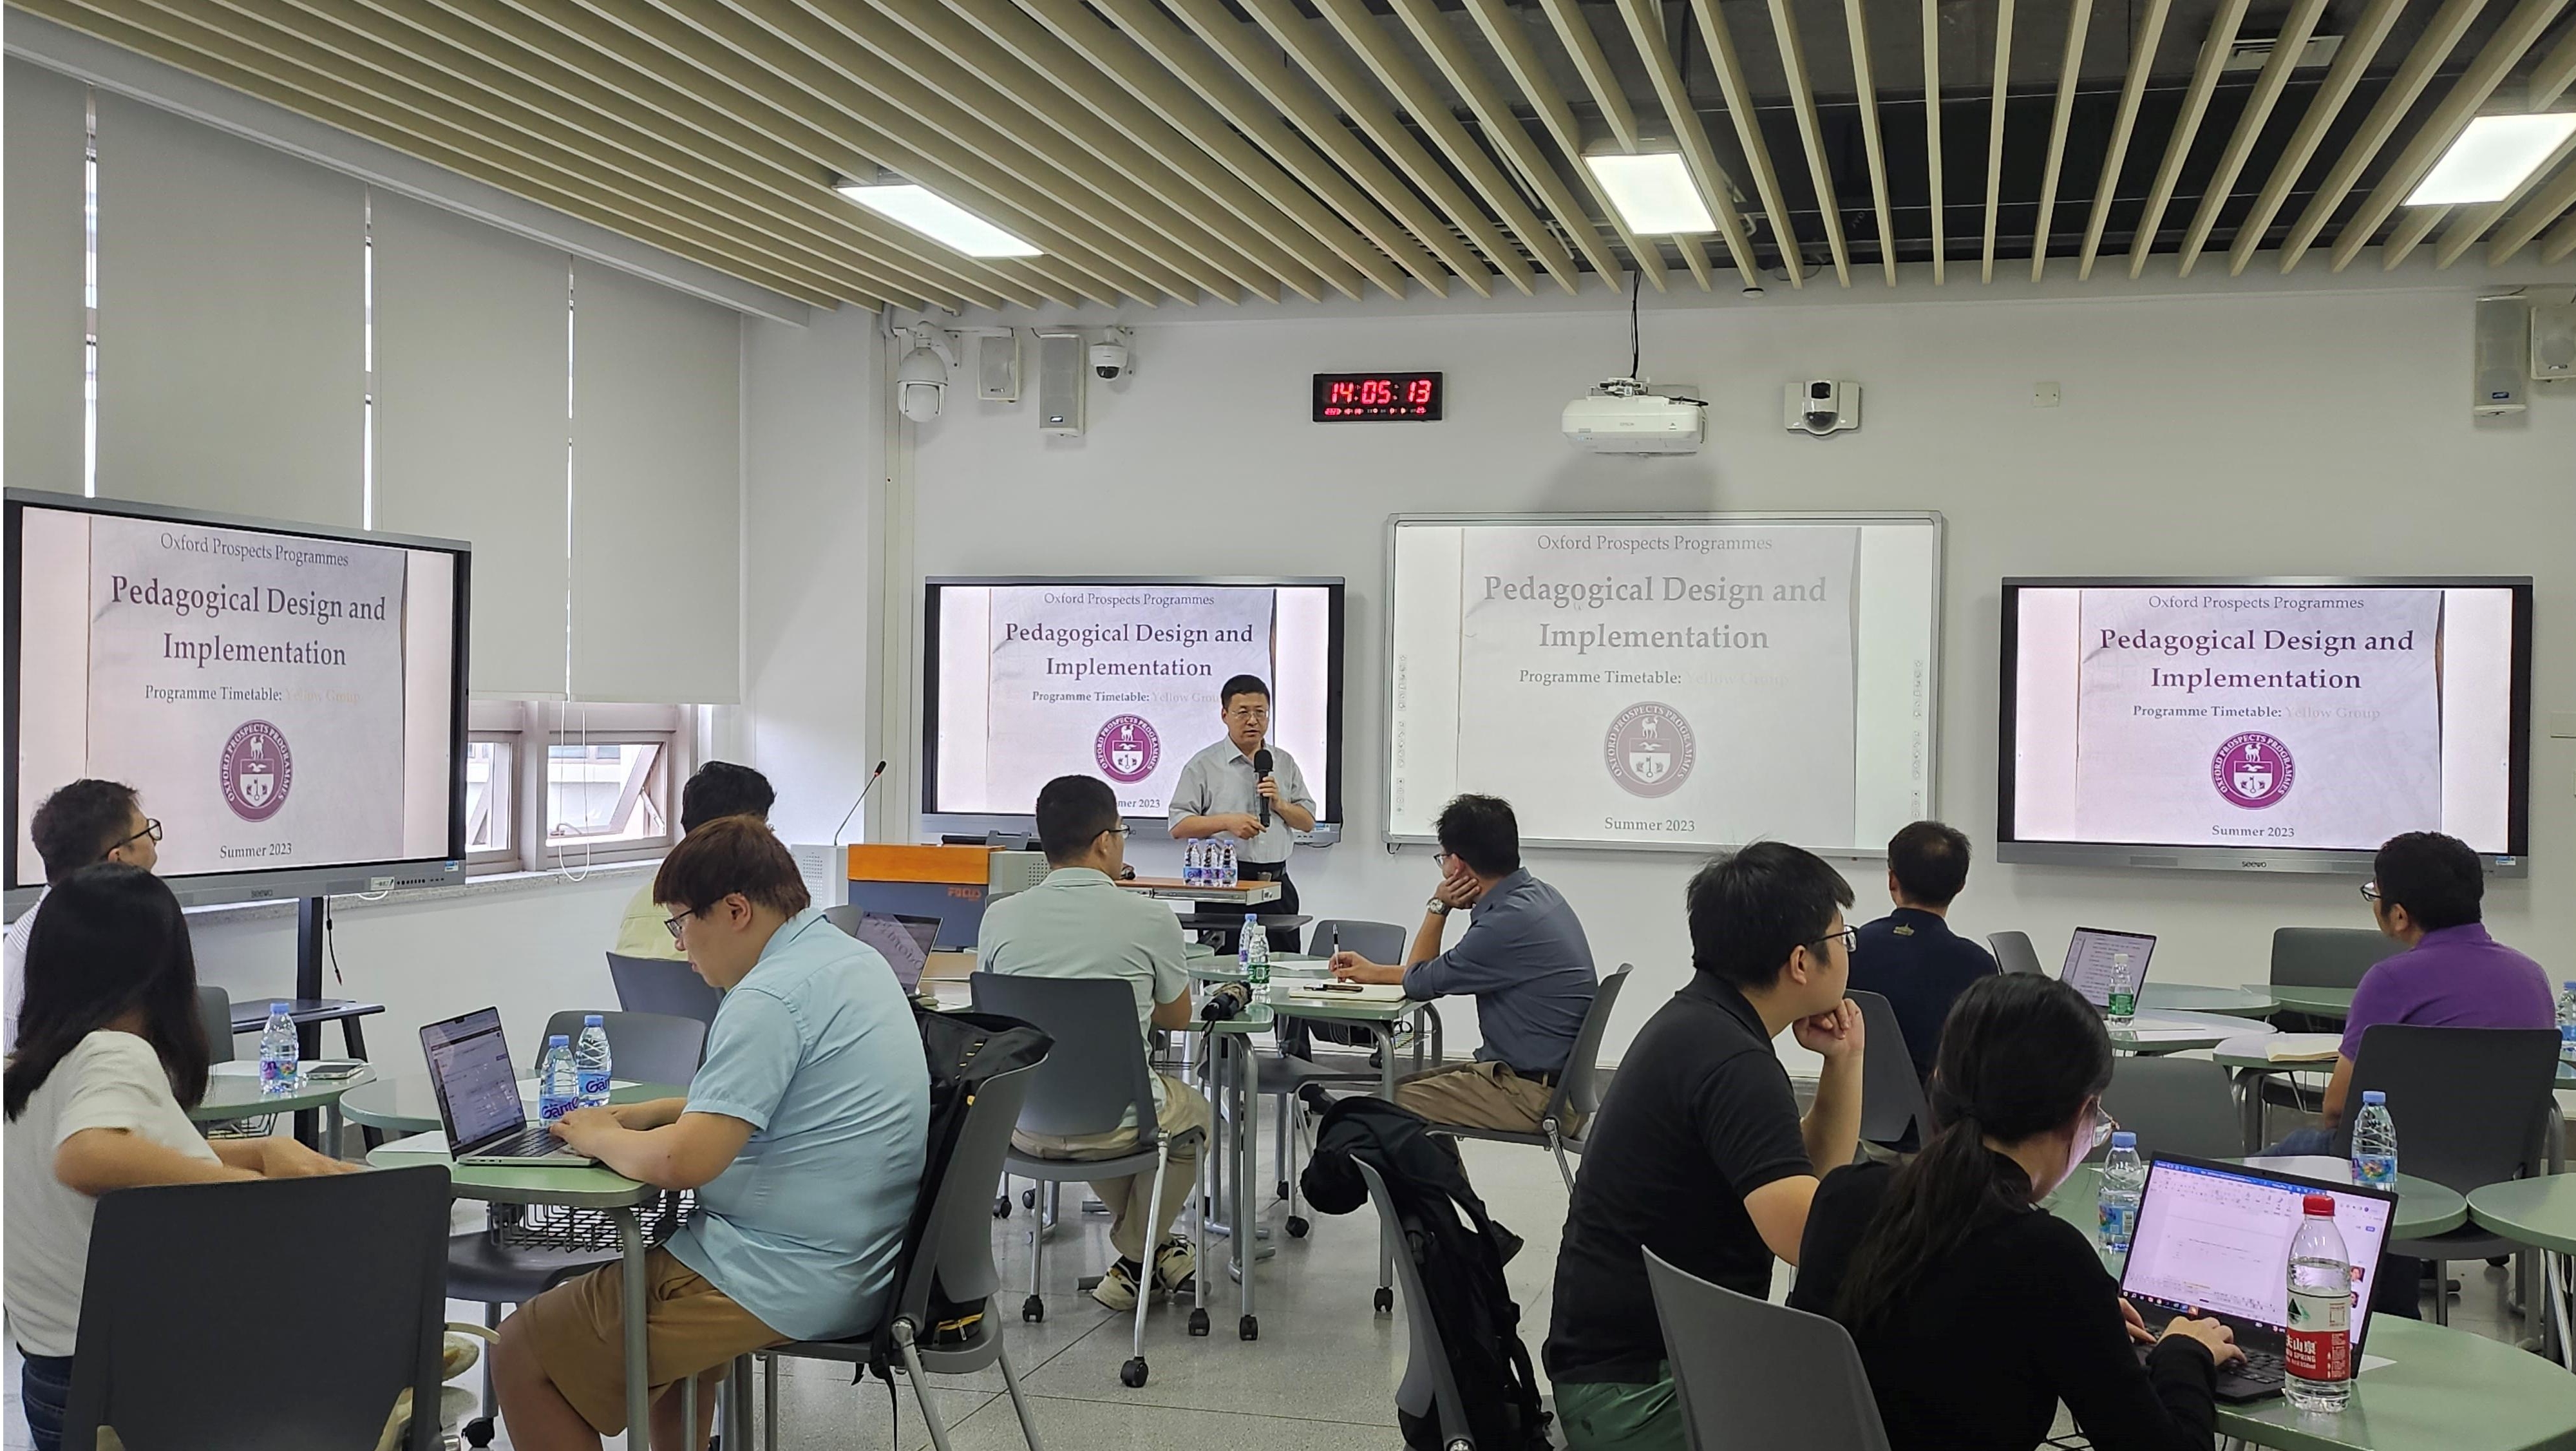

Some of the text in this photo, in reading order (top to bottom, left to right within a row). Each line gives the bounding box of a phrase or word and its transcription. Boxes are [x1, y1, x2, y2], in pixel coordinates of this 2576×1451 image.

[1331, 380, 1432, 404] 14:05:13
[160, 533, 348, 567] Oxford Prospects Programmes
[1537, 534, 1772, 555] Oxford Prospects Programmes
[111, 574, 386, 625] Pedagogical Design and
[1044, 593, 1215, 609] Oxford Prospects Programmes
[1483, 574, 1826, 610] Pedagogical Design and
[2148, 595, 2365, 612] Oxford Prospects Programmes
[1005, 622, 1253, 649] Pedagogical Design and
[1539, 623, 1770, 656] Implementation
[2099, 628, 2414, 656] Pedagogical Design and
[163, 632, 346, 669] Implementation
[1046, 657, 1213, 681] Implementation
[1519, 669, 1601, 687] Programme
[1604, 670, 1681, 684] Timetable:
[2150, 667, 2362, 694] Implementation
[146, 685, 217, 704] Programme
[220, 686, 282, 701] Timetable:
[1032, 690, 1219, 704] Programme Timetable: Yellow Grou
[1613, 706, 1664, 732] PROSPECTS
[2133, 705, 2381, 721] Programme Timetable: Yellow Group
[227, 723, 269, 754] PROSPECTS
[1608, 733, 1622, 777] OXFORD
[2214, 734, 2293, 794] OXFORD PROSPECTS PROGRAMMES
[1138, 799, 1160, 808] 2023
[1604, 817, 1695, 832] Summer 2023
[2211, 824, 2295, 838] Summer 2023
[220, 842, 292, 859] Summer 2023
